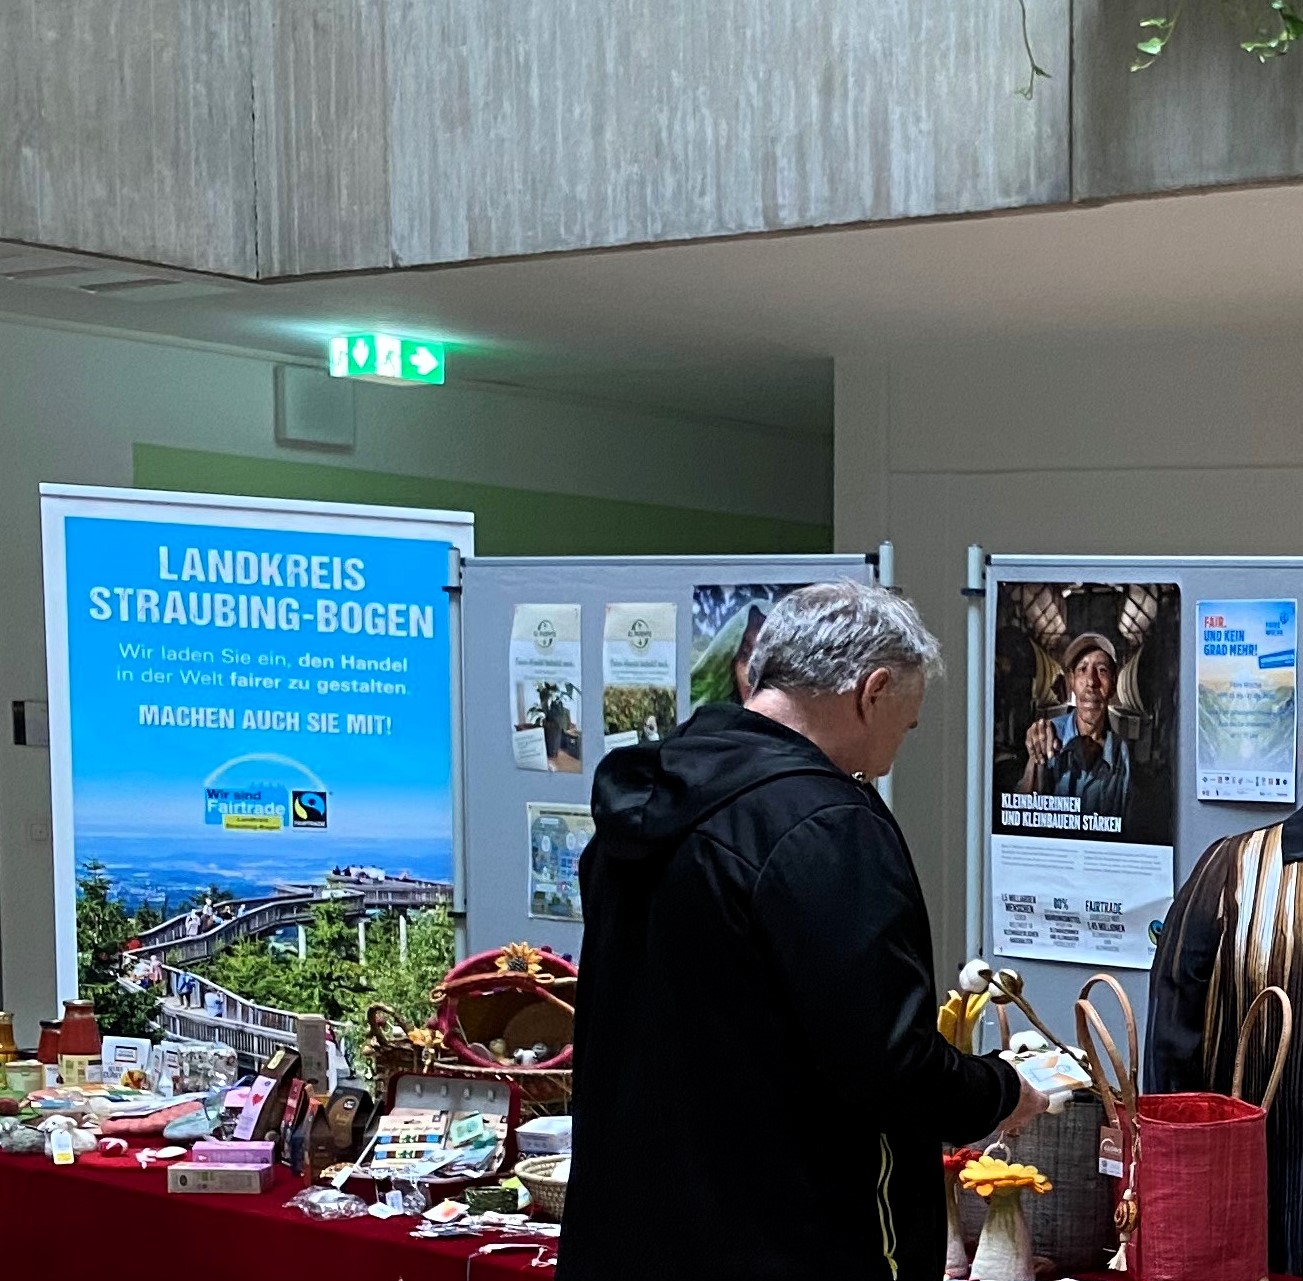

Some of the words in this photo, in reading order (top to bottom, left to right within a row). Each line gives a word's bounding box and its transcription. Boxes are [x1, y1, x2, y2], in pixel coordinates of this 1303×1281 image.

[159, 545, 366, 591] LANDKREIS
[89, 586, 434, 639] STRAUBING-BOGEN
[1204, 630, 1222, 642] UND
[1224, 630, 1245, 642] KEIN
[119, 642, 154, 660] Wir
[161, 645, 215, 663] laden
[221, 648, 252, 666] Sie
[258, 652, 292, 669] ein,
[298, 653, 335, 670] den
[341, 655, 409, 673] Handel
[1204, 644, 1228, 656] GRAD
[1230, 644, 1258, 656] MEHR!
[116, 669, 134, 682] in
[141, 668, 172, 684] der
[179, 670, 224, 686] Welt
[230, 672, 281, 690] fairer
[288, 678, 310, 691] zu
[138, 704, 234, 730] MACHEN
[242, 708, 300, 732] AUCH
[306, 712, 340, 734] SIE
[346, 714, 392, 736] MIT!
[206, 800, 286, 816] Fairtrade
[1001, 792, 1081, 812] KLEINBÄUERINNEN
[1002, 810, 1020, 826] UND
[1022, 812, 1081, 830] KLEINBAUERN
[1082, 812, 1122, 833] STÄRKEN
[1086, 900, 1123, 915] FAIRTRADE
